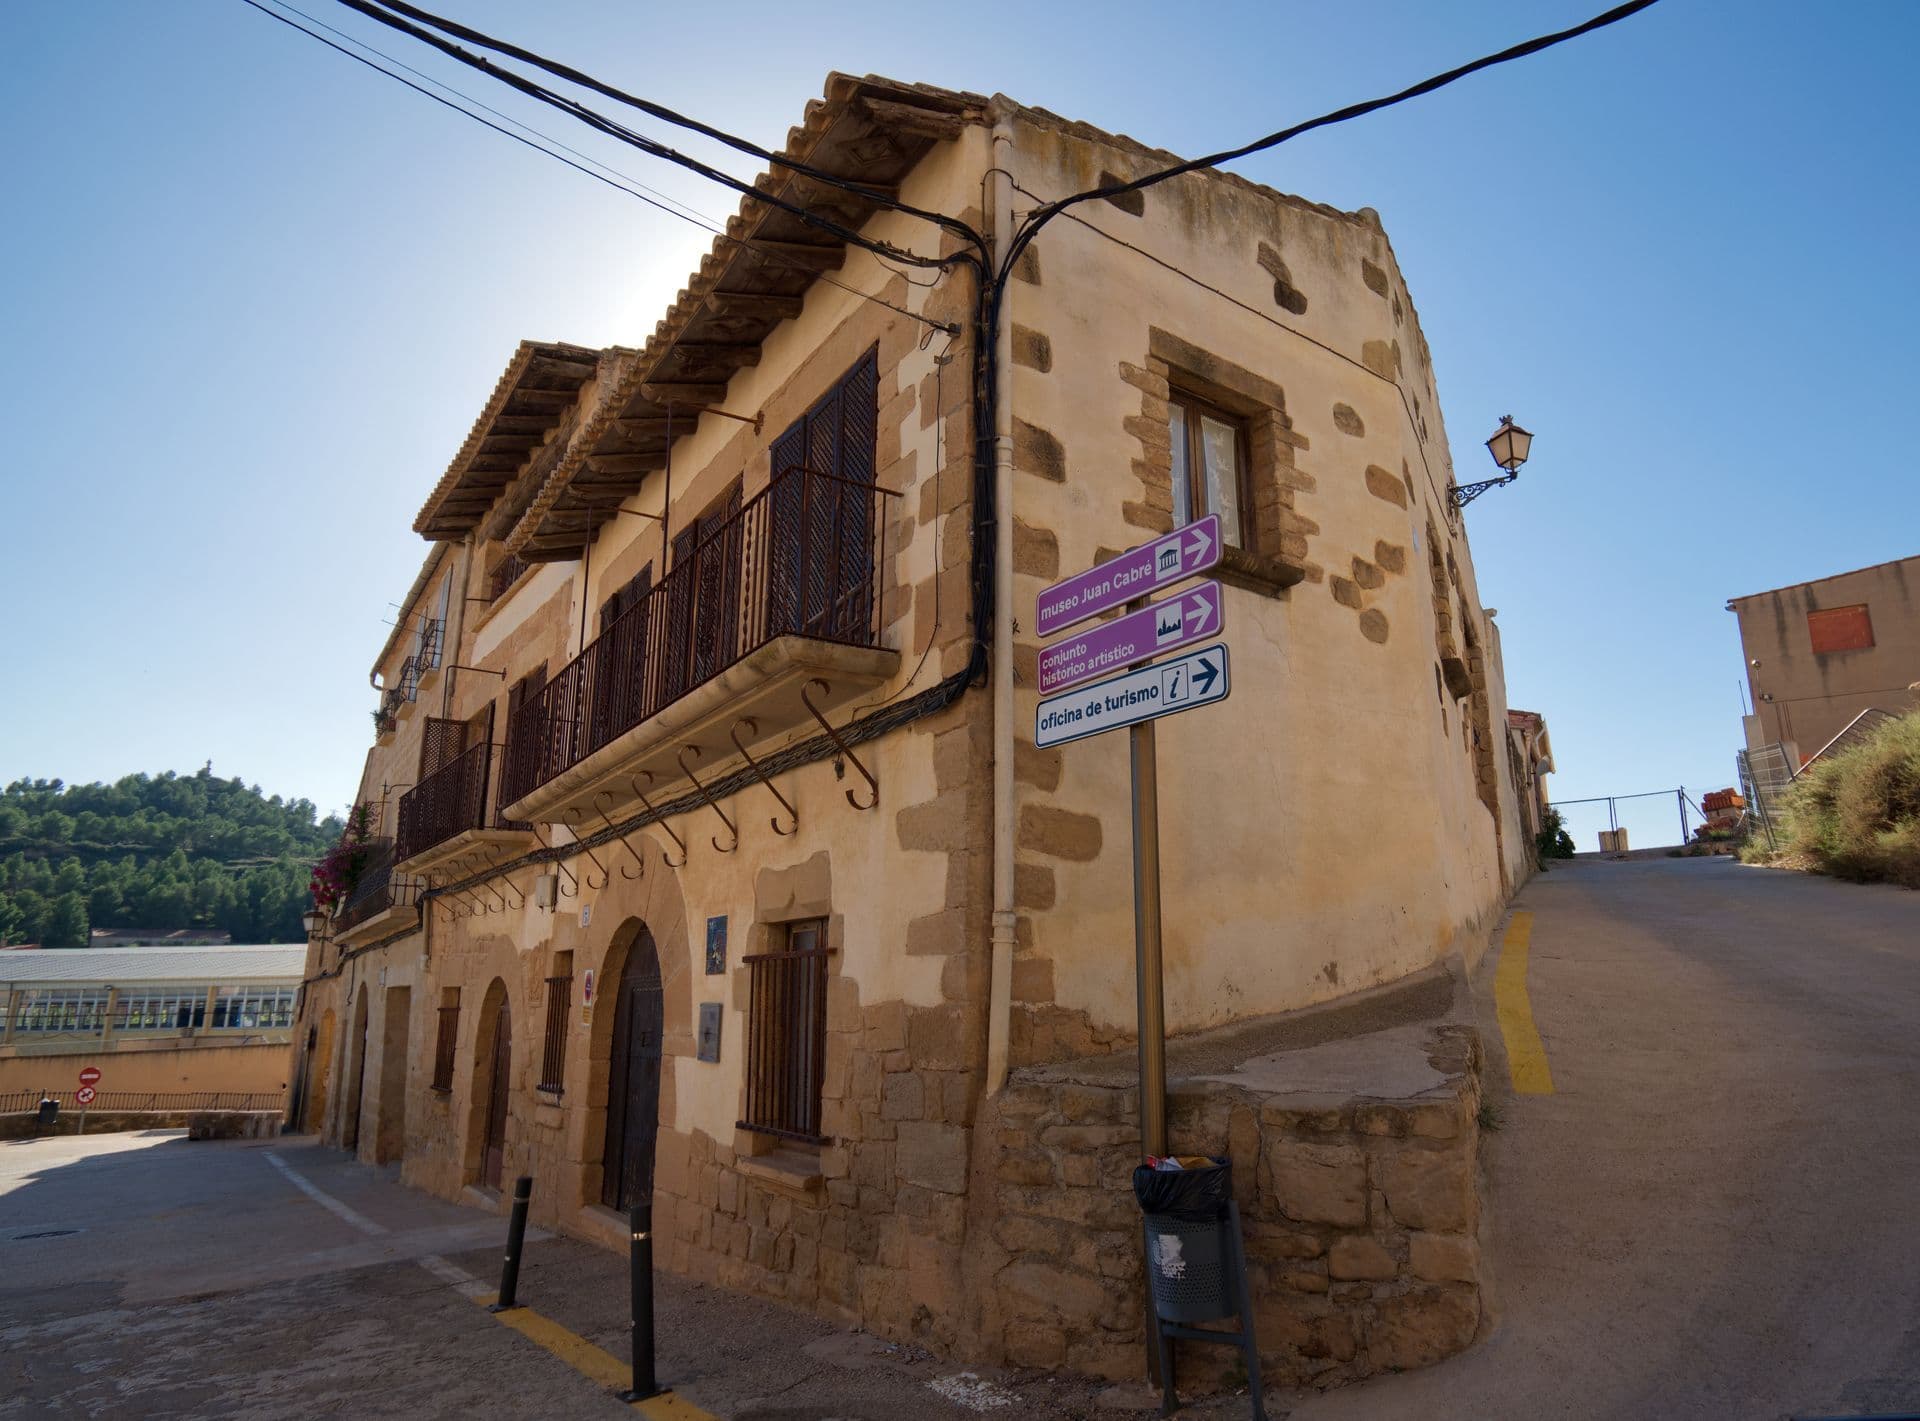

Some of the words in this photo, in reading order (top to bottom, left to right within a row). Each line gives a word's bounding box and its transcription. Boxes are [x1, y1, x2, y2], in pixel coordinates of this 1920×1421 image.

[1041, 596, 1079, 621] museo
[1082, 580, 1110, 604] Juan
[1113, 560, 1152, 588] Cabré
[1043, 643, 1087, 670] conjunto
[1041, 708, 1083, 731] oficina
[1086, 700, 1102, 718] de
[1105, 685, 1159, 711] turismo
